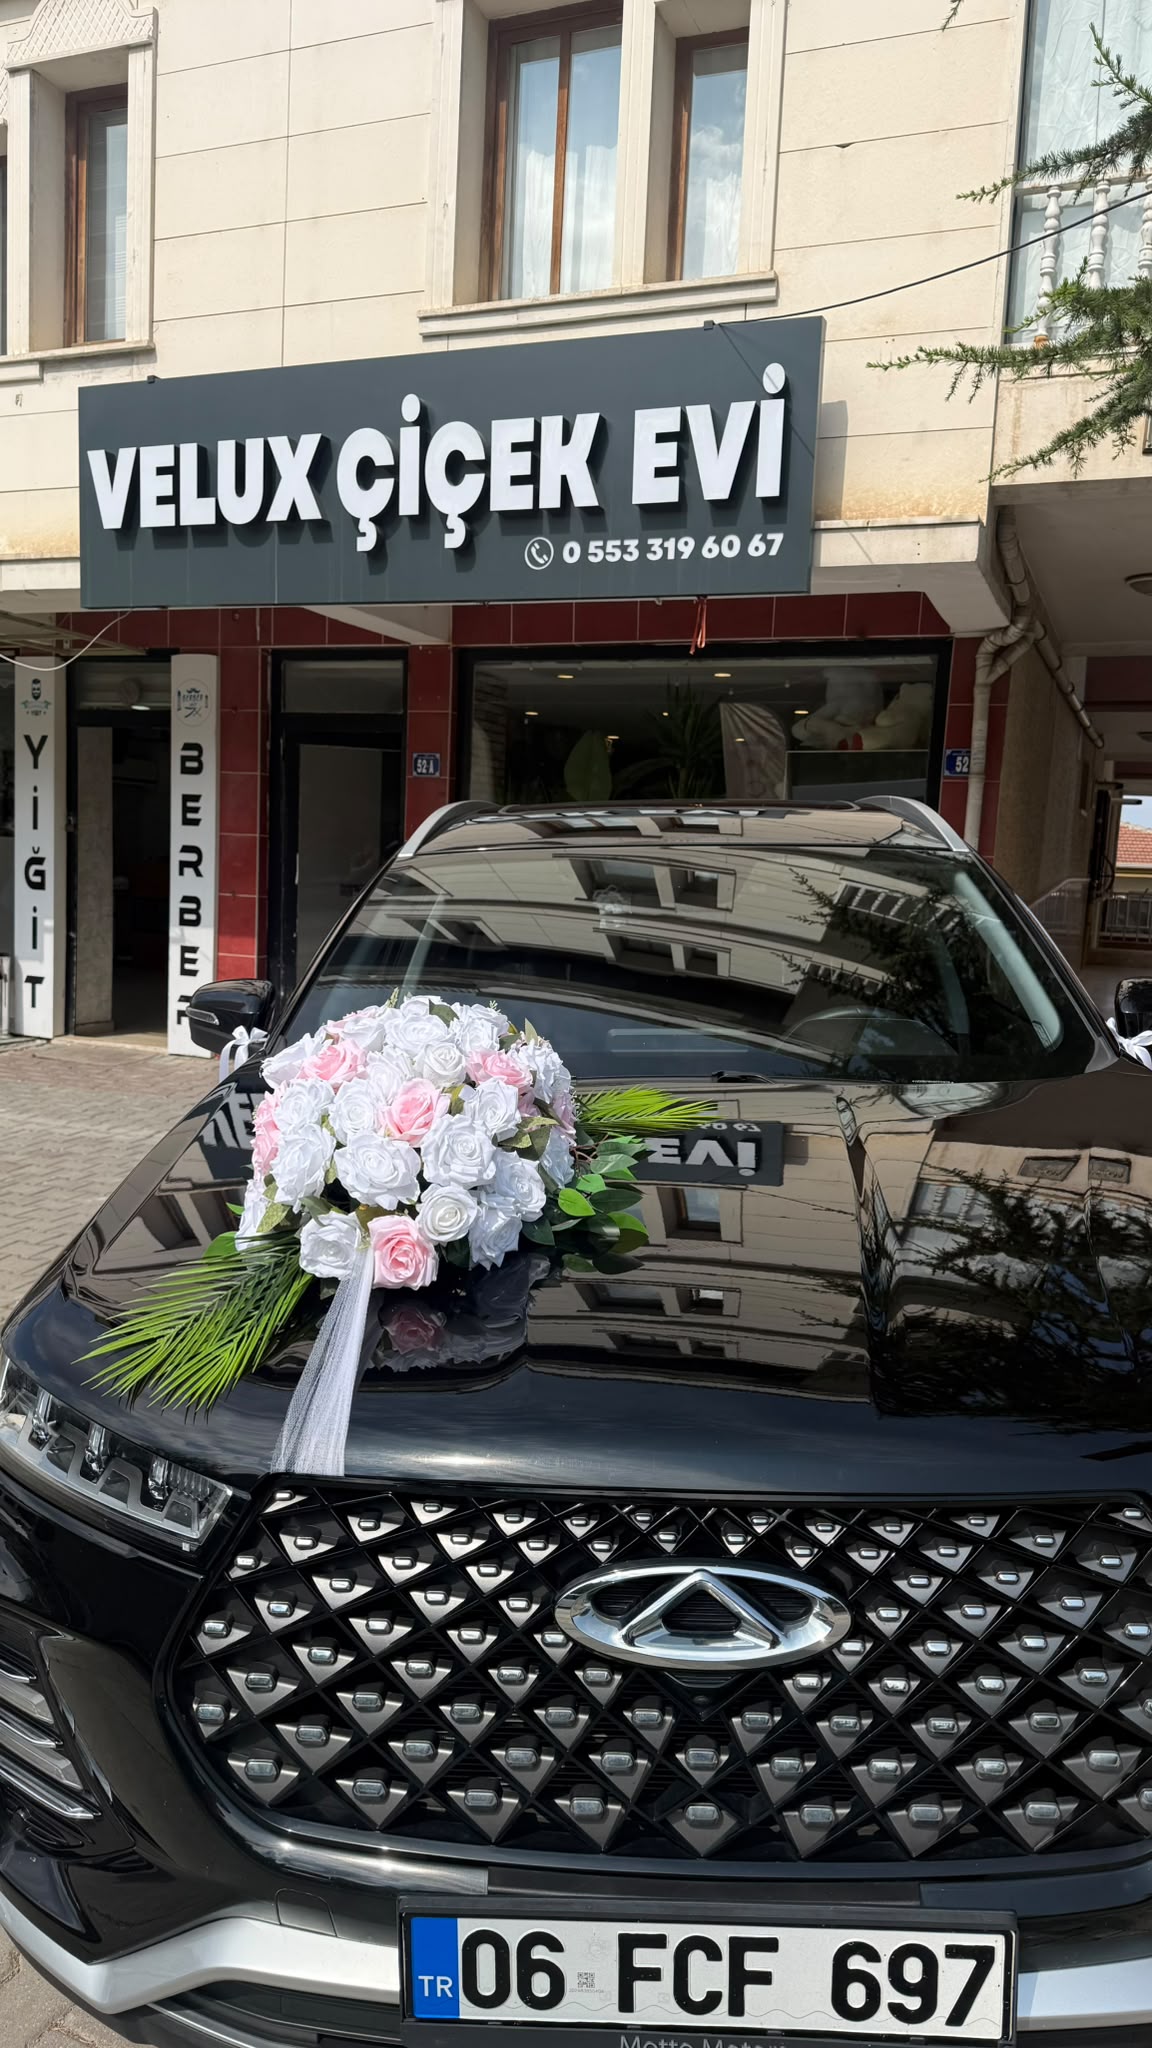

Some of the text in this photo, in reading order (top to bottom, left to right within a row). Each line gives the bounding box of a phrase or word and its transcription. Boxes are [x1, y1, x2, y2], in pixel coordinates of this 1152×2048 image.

[87, 362, 786, 553] VELUX ÇİÇEK EVİ
[562, 532, 784, 564] 0 553 319 60 67
[955, 756, 969, 772] 52
[24, 734, 48, 1009] YİĞİT
[419, 1976, 453, 1998] TR
[462, 1929, 995, 2026] 06 FCF 697
